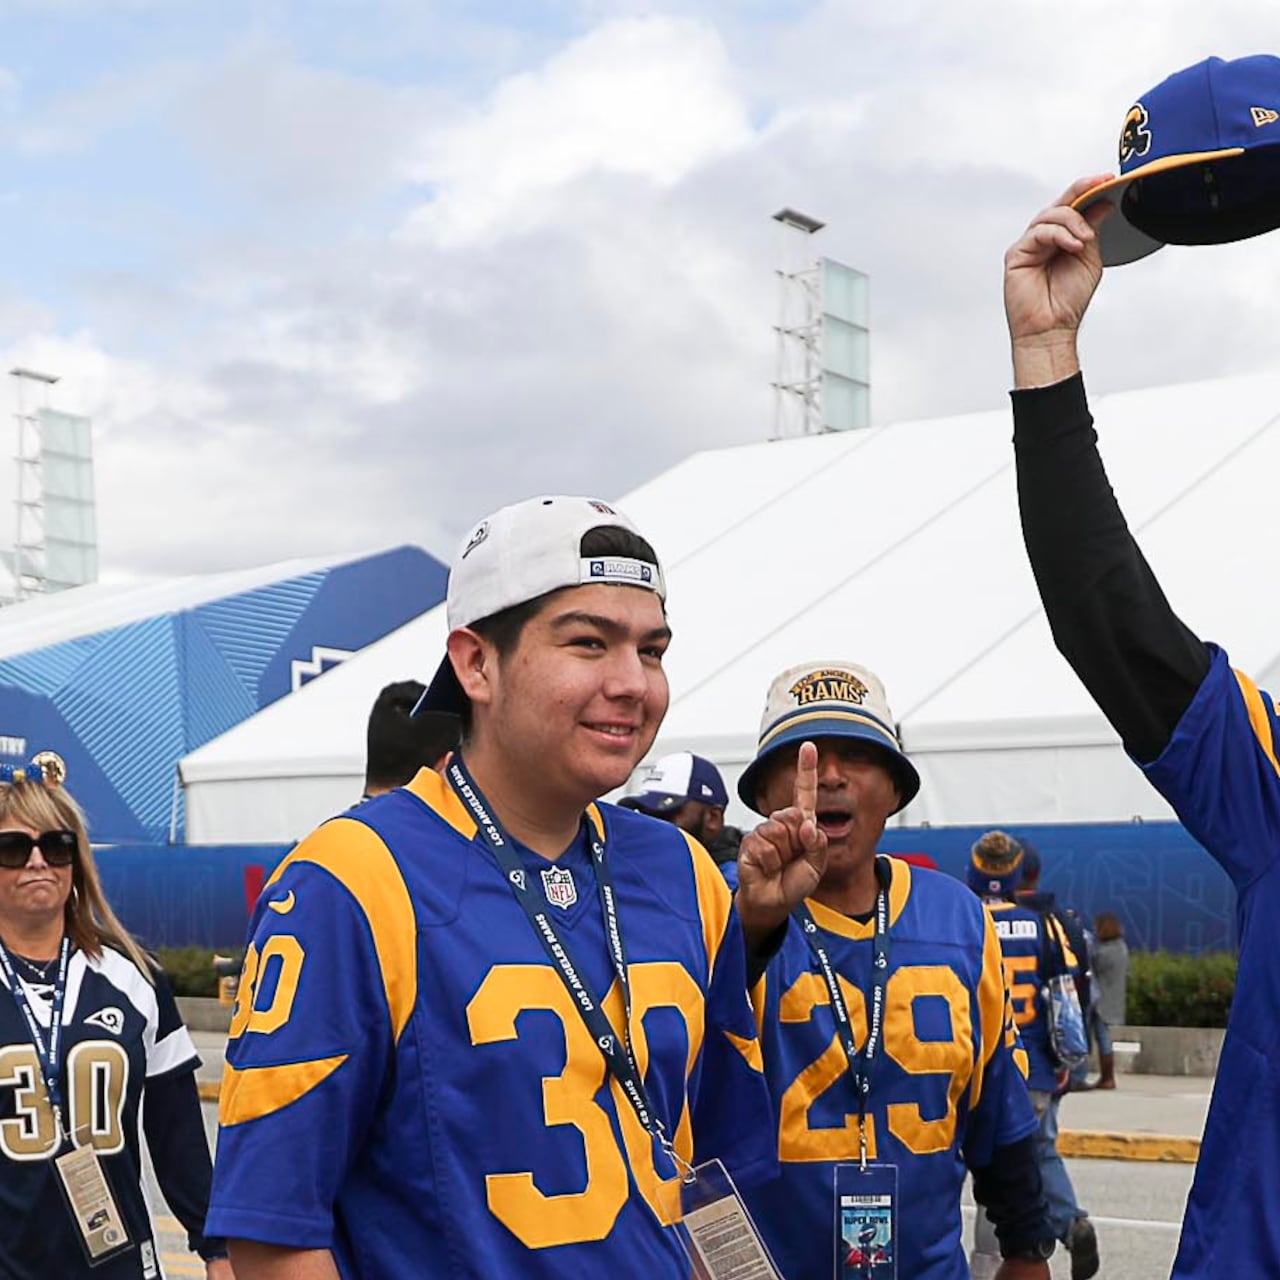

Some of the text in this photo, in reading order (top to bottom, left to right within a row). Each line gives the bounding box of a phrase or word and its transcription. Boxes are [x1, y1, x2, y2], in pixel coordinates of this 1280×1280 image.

[800, 680, 862, 704] RAMS
[461, 785, 493, 825] ANGELES
[487, 825, 505, 846] LOS
[550, 885, 574, 900] NFL
[604, 885, 616, 915] RAMS
[535, 913, 594, 1011] LOS ANGELES RAMS
[873, 986, 882, 1001] LOS
[871, 1003, 881, 1037] ANGELES
[778, 965, 973, 1163] 29
[466, 962, 706, 1249] 30
